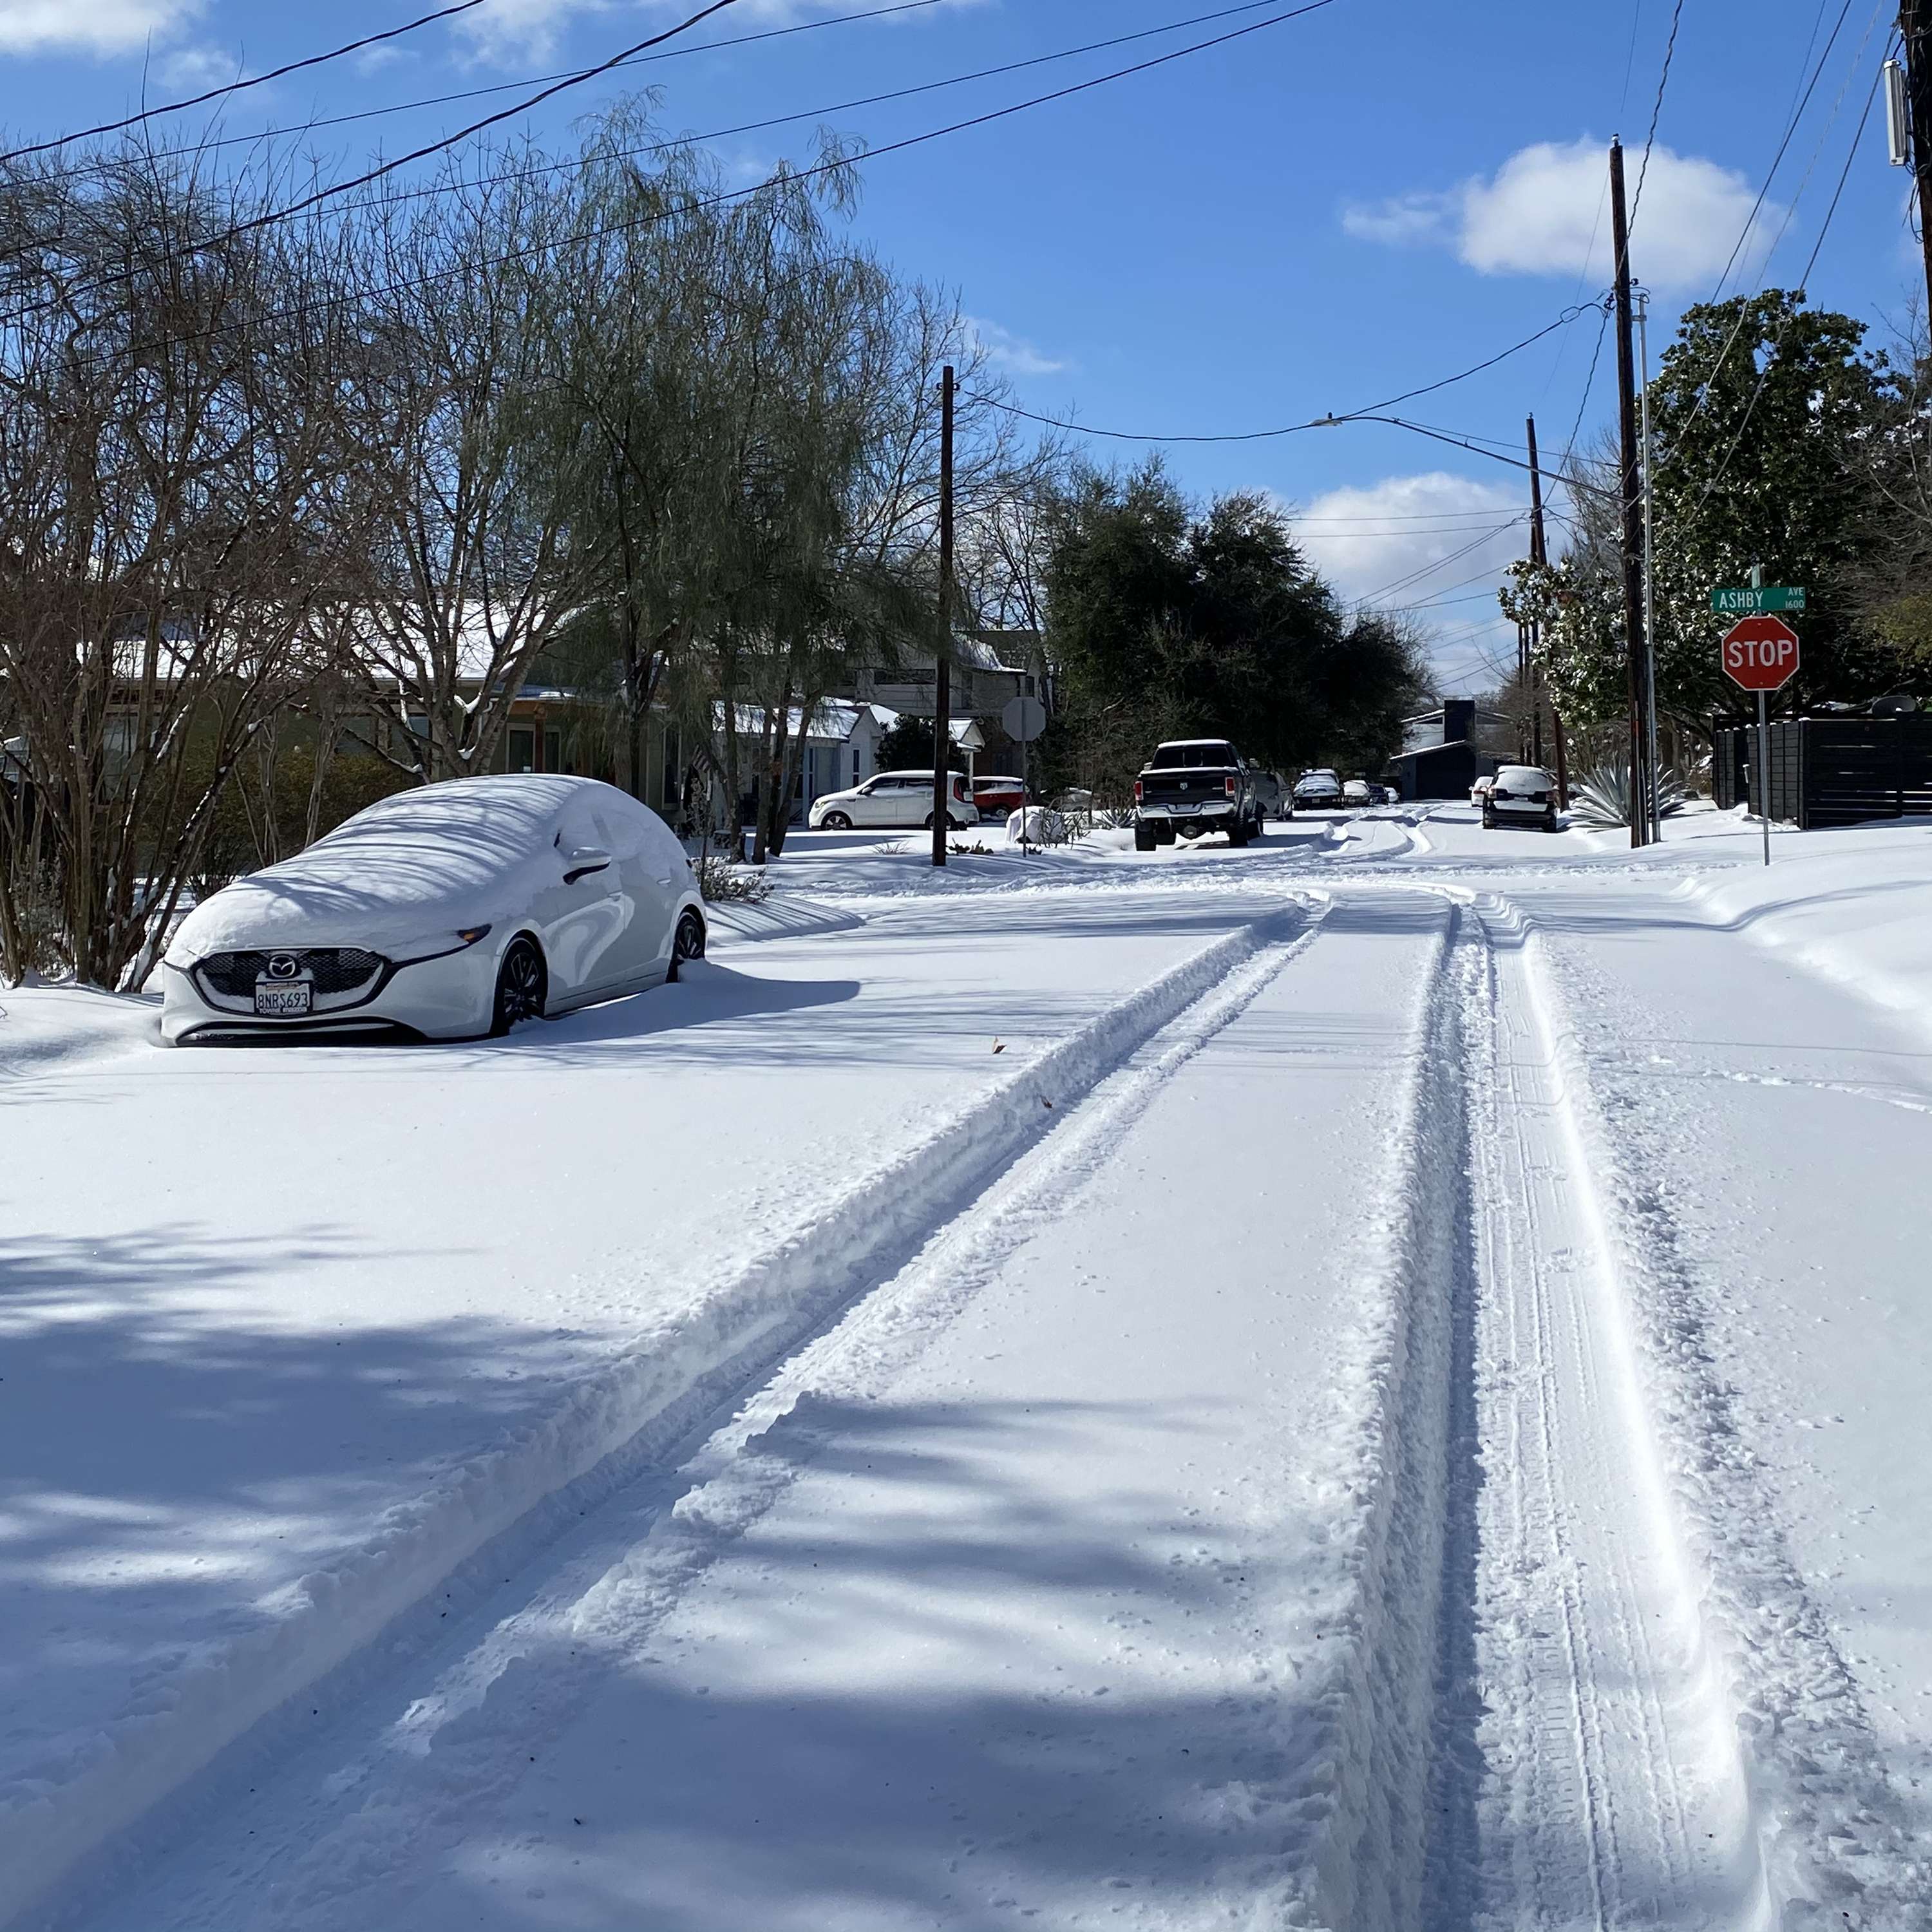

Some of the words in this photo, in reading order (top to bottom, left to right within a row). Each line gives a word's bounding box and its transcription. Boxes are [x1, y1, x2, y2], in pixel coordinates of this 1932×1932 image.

[1719, 591, 1763, 608] ASHBY
[1788, 587, 1804, 596] AVE
[1785, 600, 1804, 609] 1600
[1728, 639, 1793, 667] STOP
[258, 992, 308, 1008] 8NRS693
